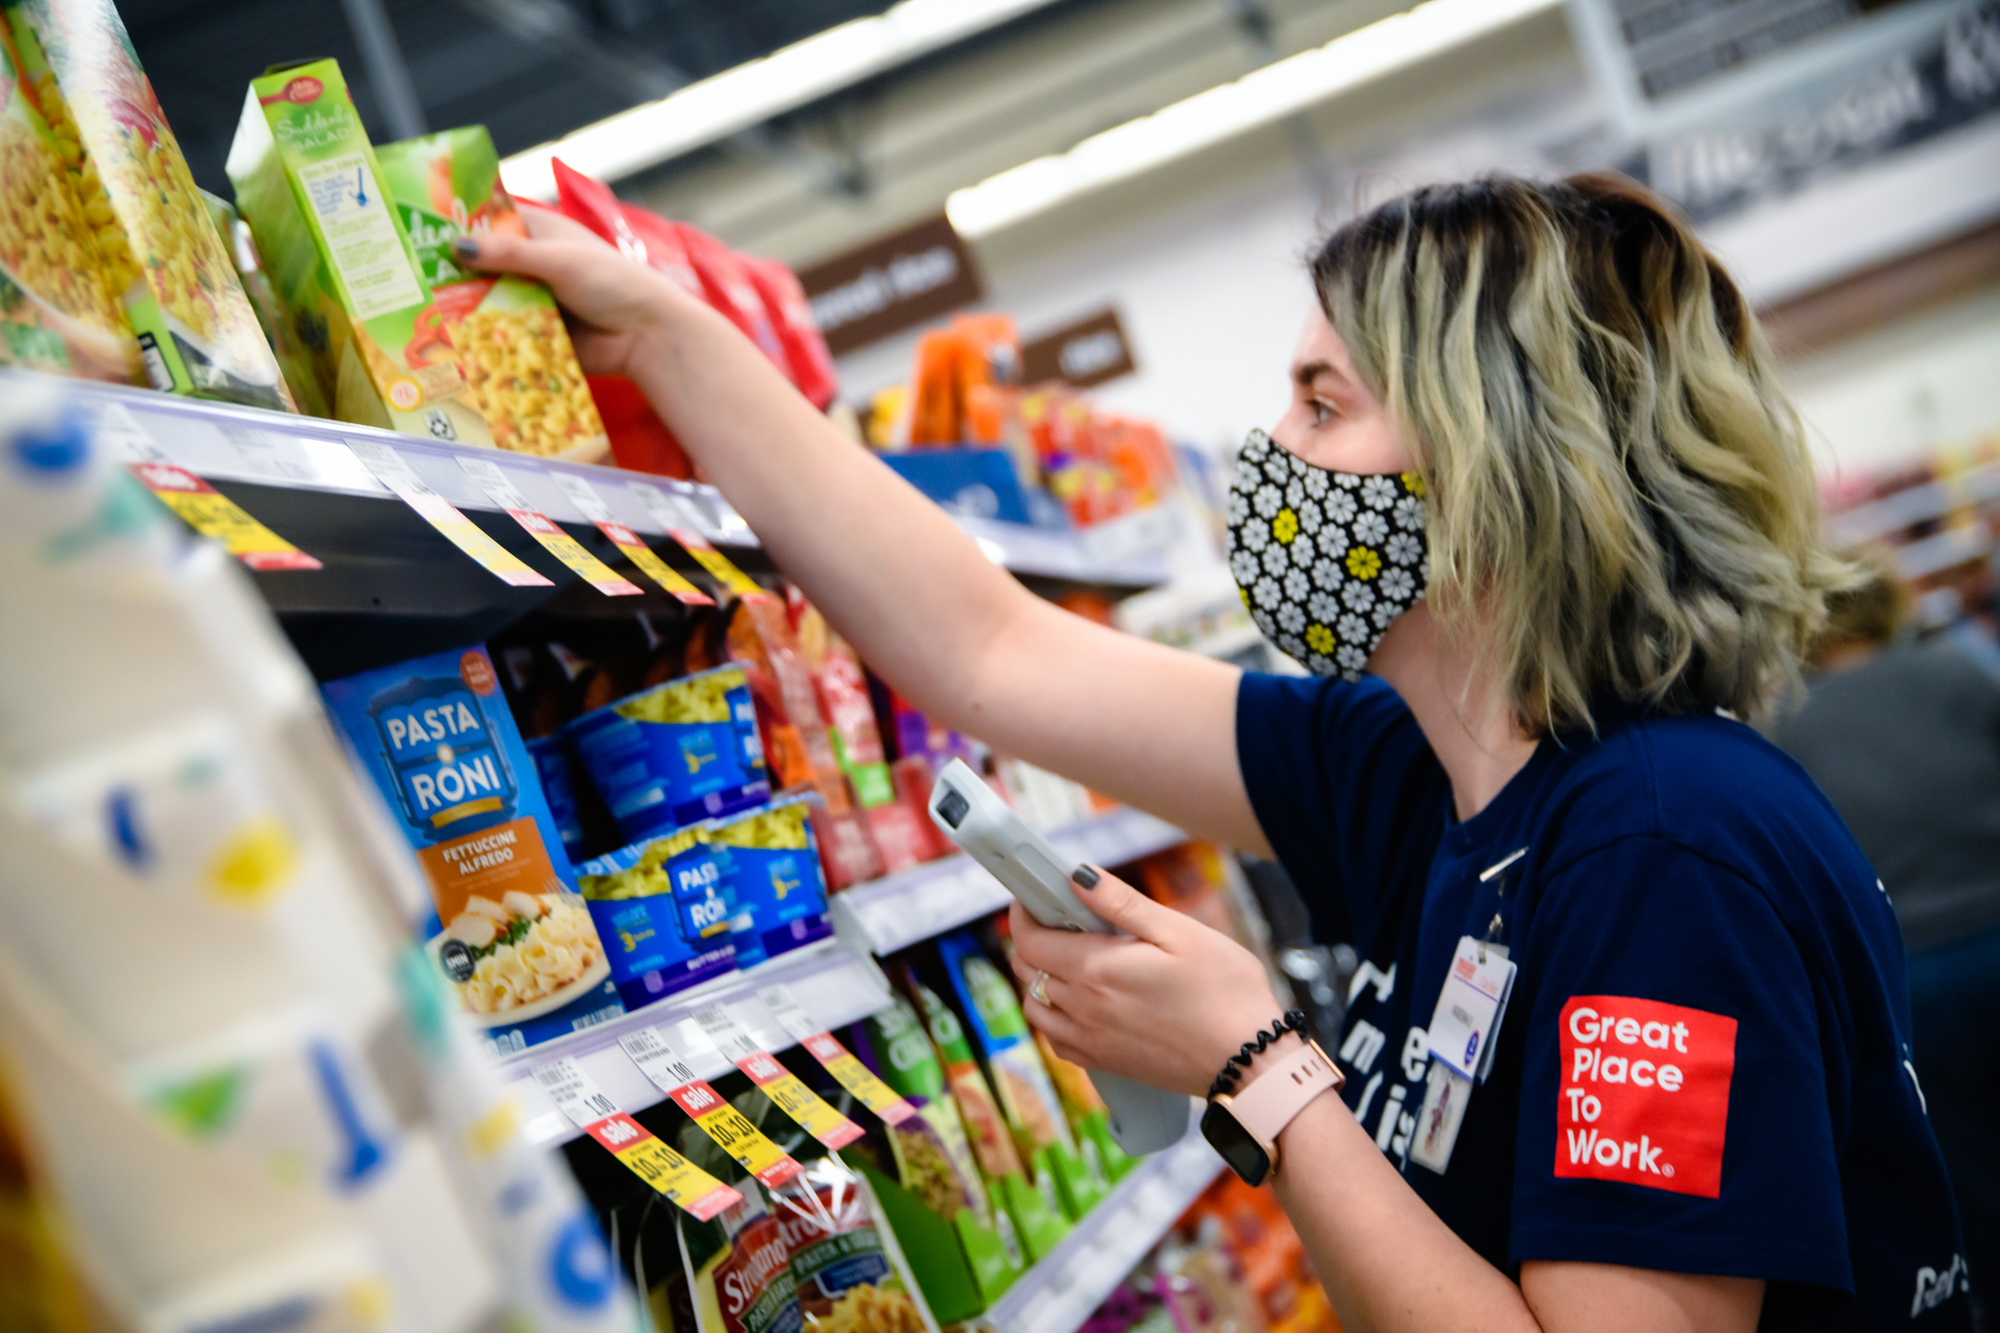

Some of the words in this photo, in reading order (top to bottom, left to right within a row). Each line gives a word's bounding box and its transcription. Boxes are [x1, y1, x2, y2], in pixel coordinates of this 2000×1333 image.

[276, 103, 355, 139] Suddenly
[387, 701, 480, 750] PASTA
[411, 755, 500, 810] RONI
[442, 829, 518, 863] FETTUCCINE
[459, 847, 514, 875] ALFREDO
[1569, 1007, 1690, 1054] Great
[665, 1061, 695, 1083] 1.00
[747, 1056, 779, 1079] sale
[1572, 1047, 1684, 1092] Place
[583, 1093, 617, 1116] 1.00
[681, 1084, 715, 1111] sale
[1565, 1088, 1602, 1123] To
[599, 1118, 639, 1145] sale
[709, 1124, 735, 1147] 10
[631, 1156, 663, 1181] 10
